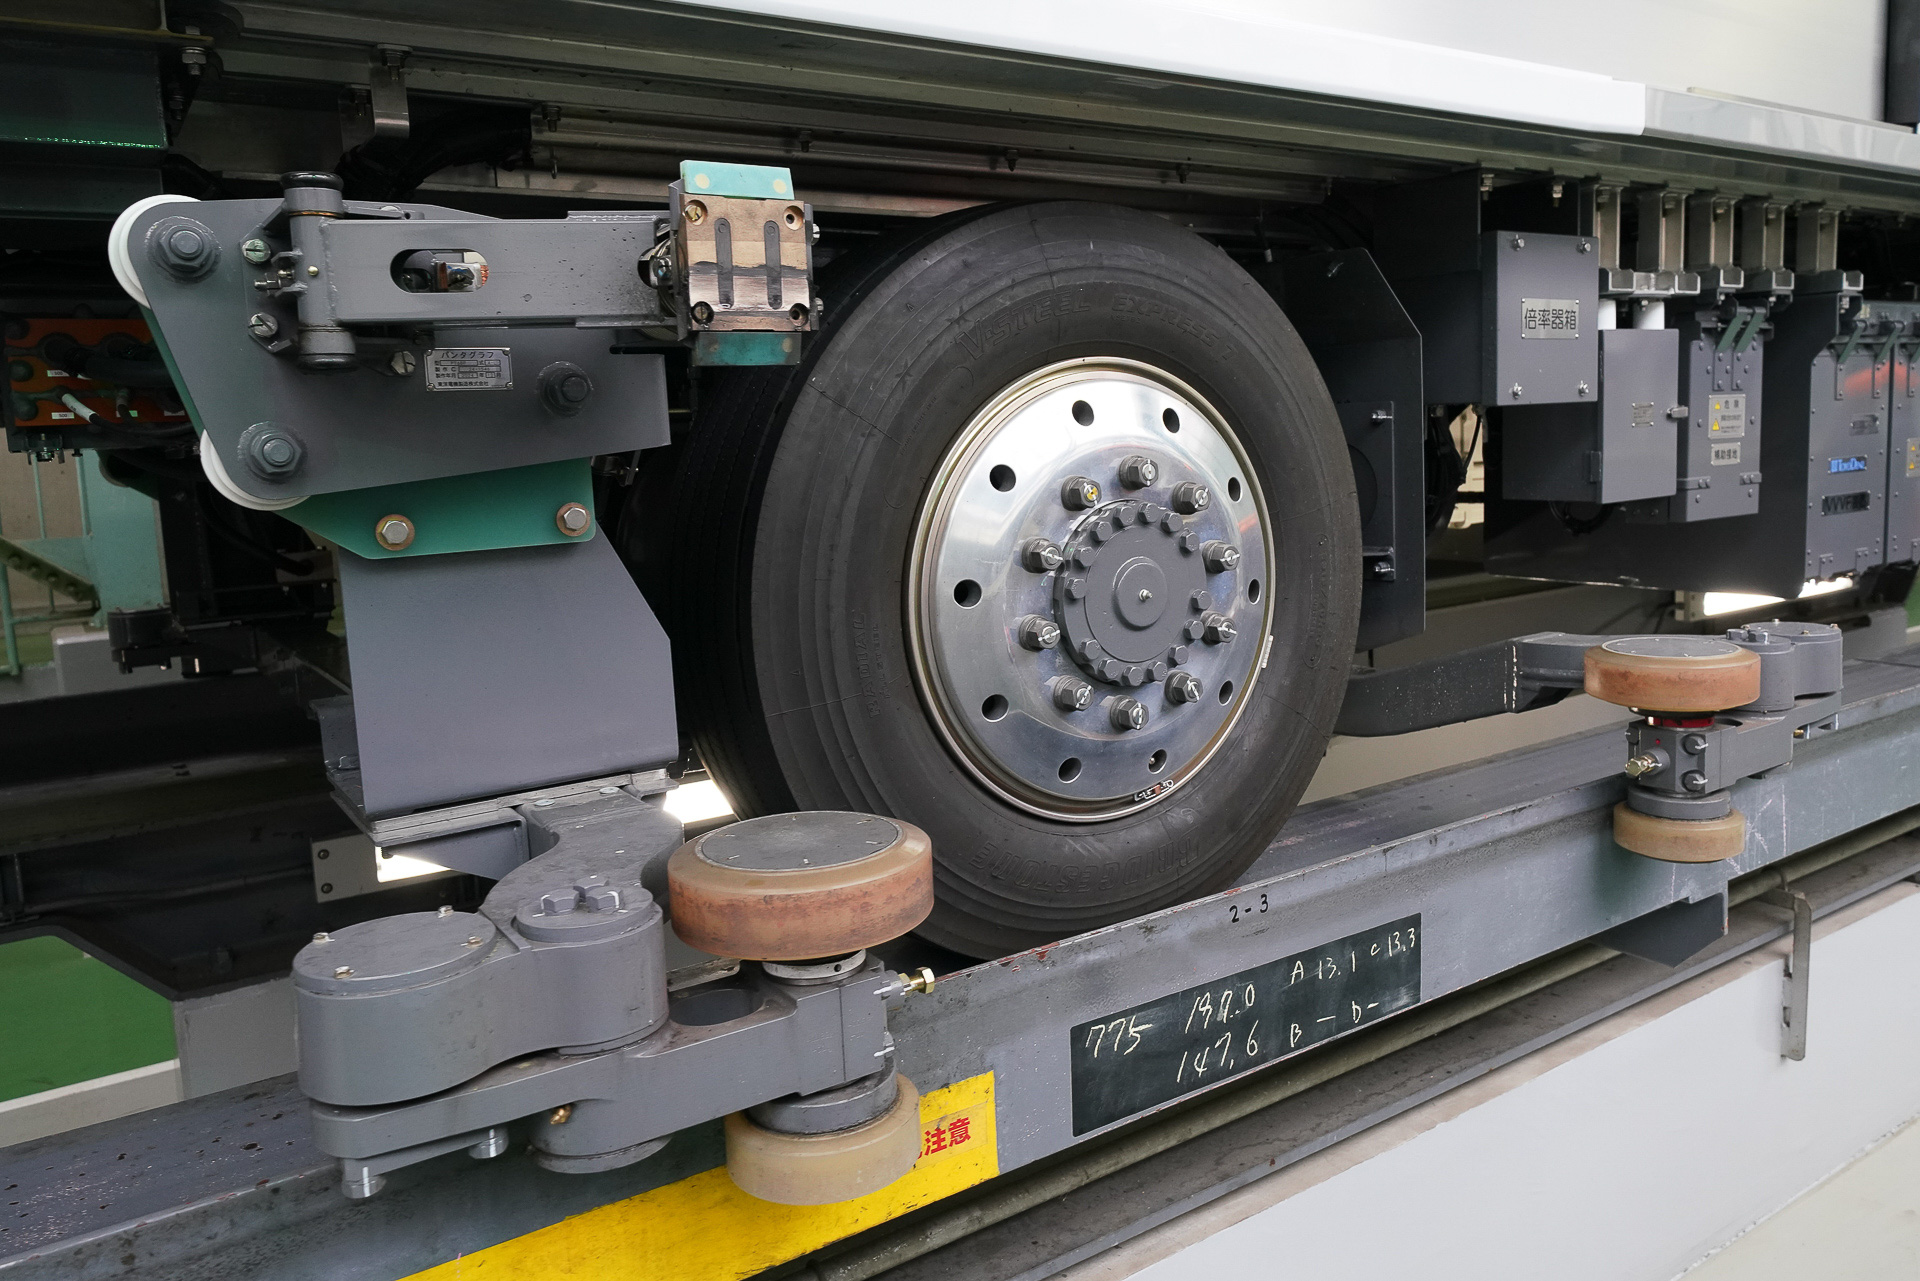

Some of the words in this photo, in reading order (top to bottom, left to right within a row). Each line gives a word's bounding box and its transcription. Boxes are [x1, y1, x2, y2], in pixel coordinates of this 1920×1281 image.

[954, 289, 1091, 361] V-STEEL
[1112, 293, 1220, 349] EXPRESS
[1524, 308, 1577, 330] 倍率器箱
[441, 351, 494, 359] パンタグラフ
[852, 613, 881, 718] RADIAL
[968, 825, 1200, 894] BRIDGESTONE
[1085, 1015, 1152, 1058] 775
[1290, 960, 1304, 985] A
[1388, 928, 1416, 957] 13.3
[1290, 1023, 1303, 1048] B
[917, 1116, 972, 1160] 注意
